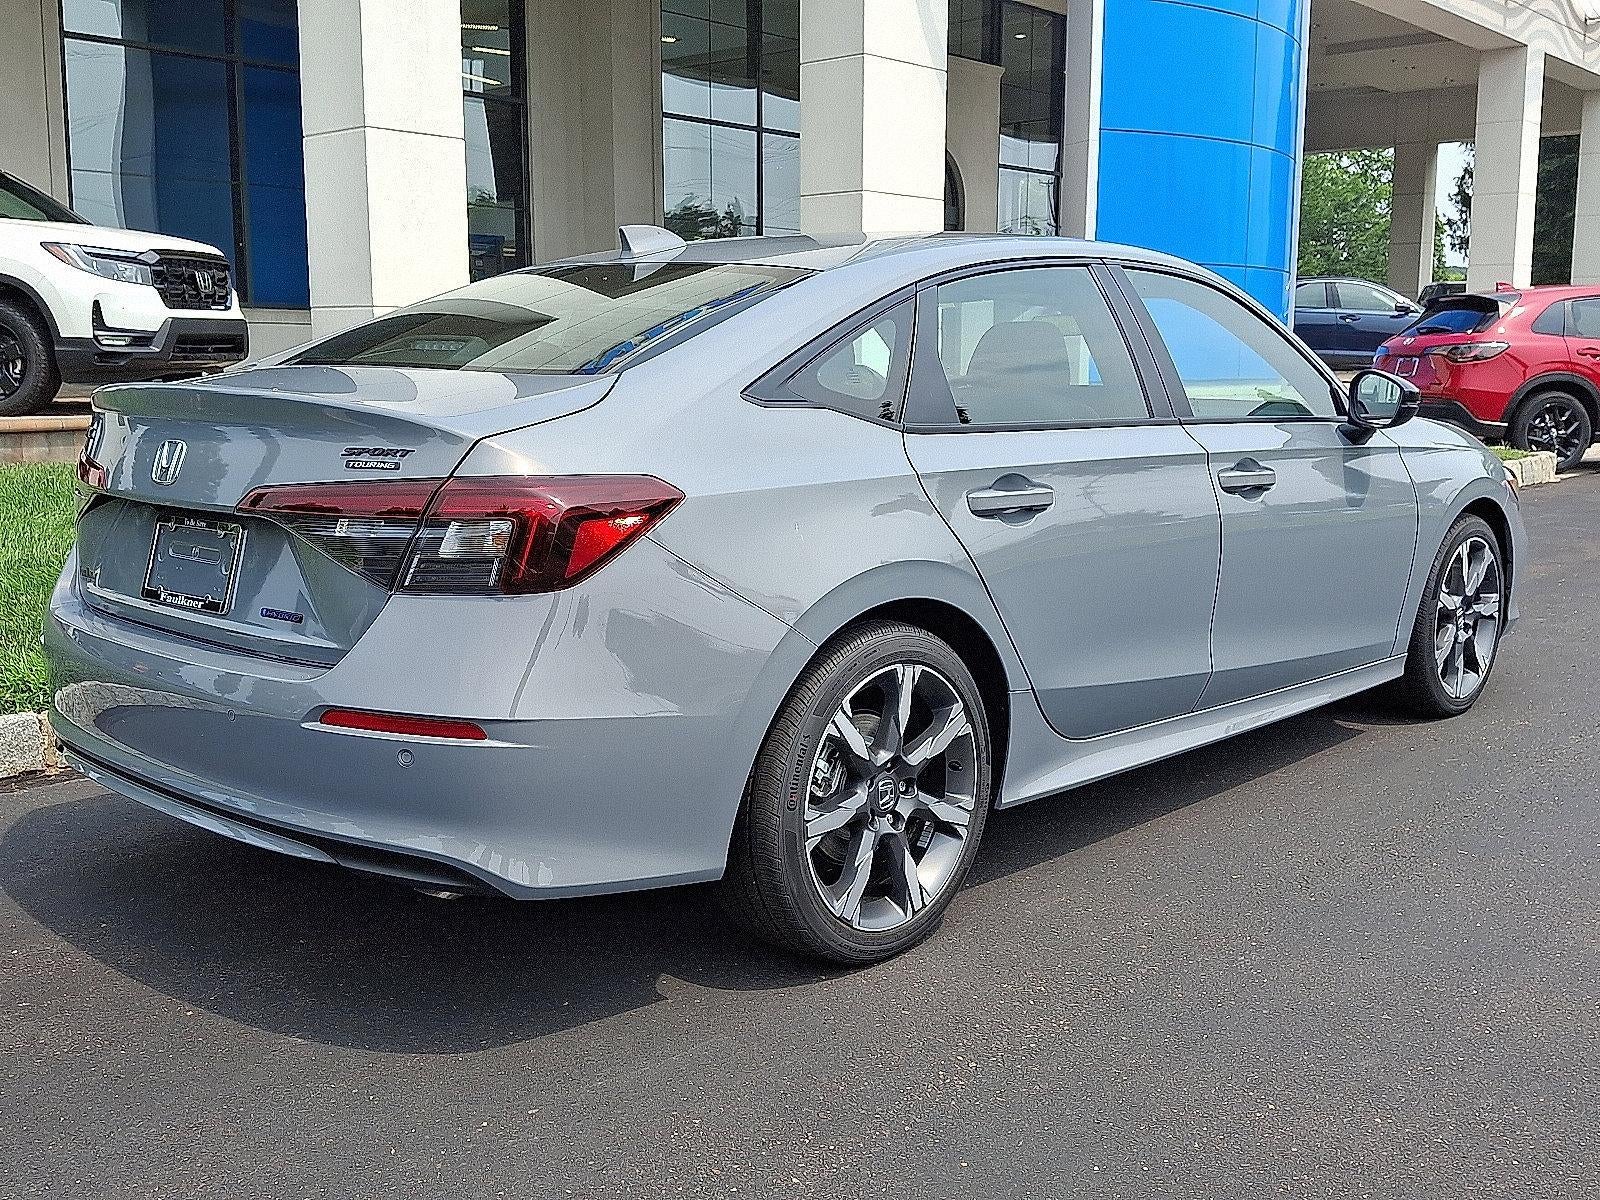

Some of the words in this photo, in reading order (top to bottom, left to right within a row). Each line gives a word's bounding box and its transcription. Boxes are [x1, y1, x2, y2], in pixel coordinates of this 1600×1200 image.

[341, 447, 415, 457] SPORT
[160, 592, 205, 608] Faulkner
[786, 742, 809, 811] Continental
